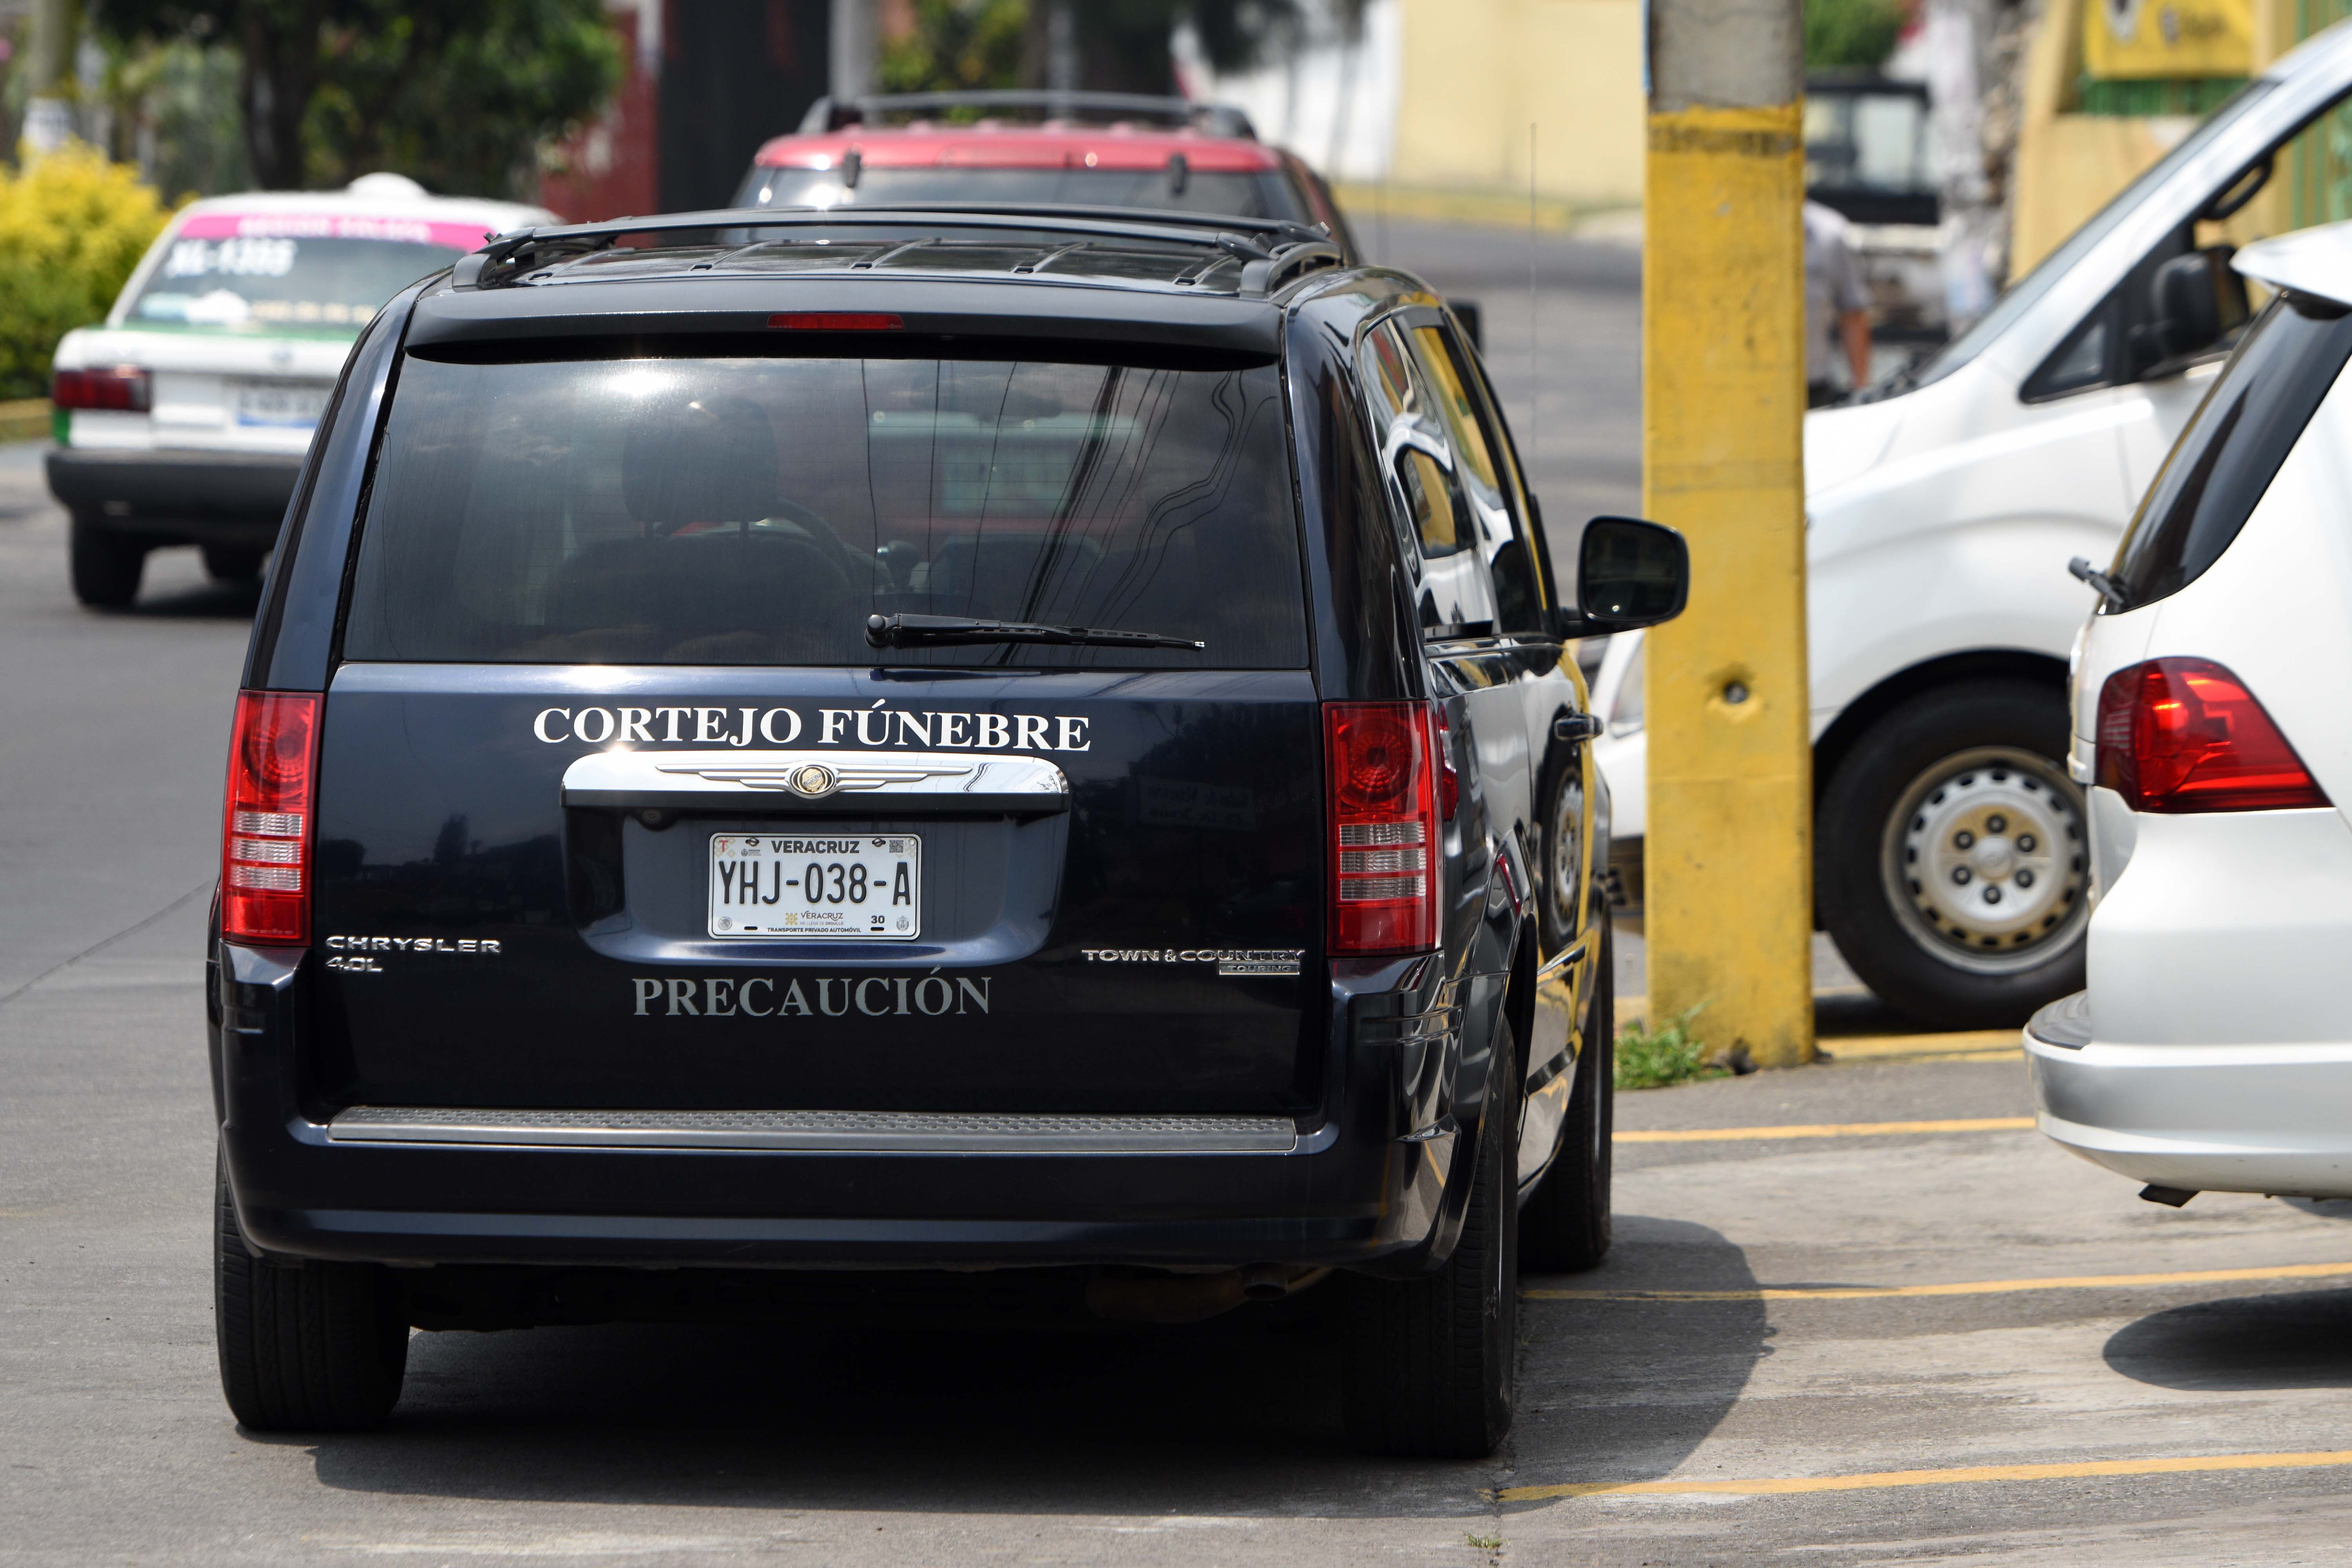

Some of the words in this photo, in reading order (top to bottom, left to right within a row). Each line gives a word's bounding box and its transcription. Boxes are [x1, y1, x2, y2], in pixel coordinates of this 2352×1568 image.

[534, 707, 802, 746] CORTEJO
[817, 699, 1091, 751] FÚNEBRE
[719, 840, 728, 852] T
[771, 840, 860, 853] VERACRUZ
[719, 861, 911, 905] YHJ-038-A
[801, 911, 843, 921] VERACRUZ
[871, 915, 885, 924] 30
[325, 936, 501, 953] CHRYSLER
[631, 964, 991, 1016] PRECAUCIÓN
